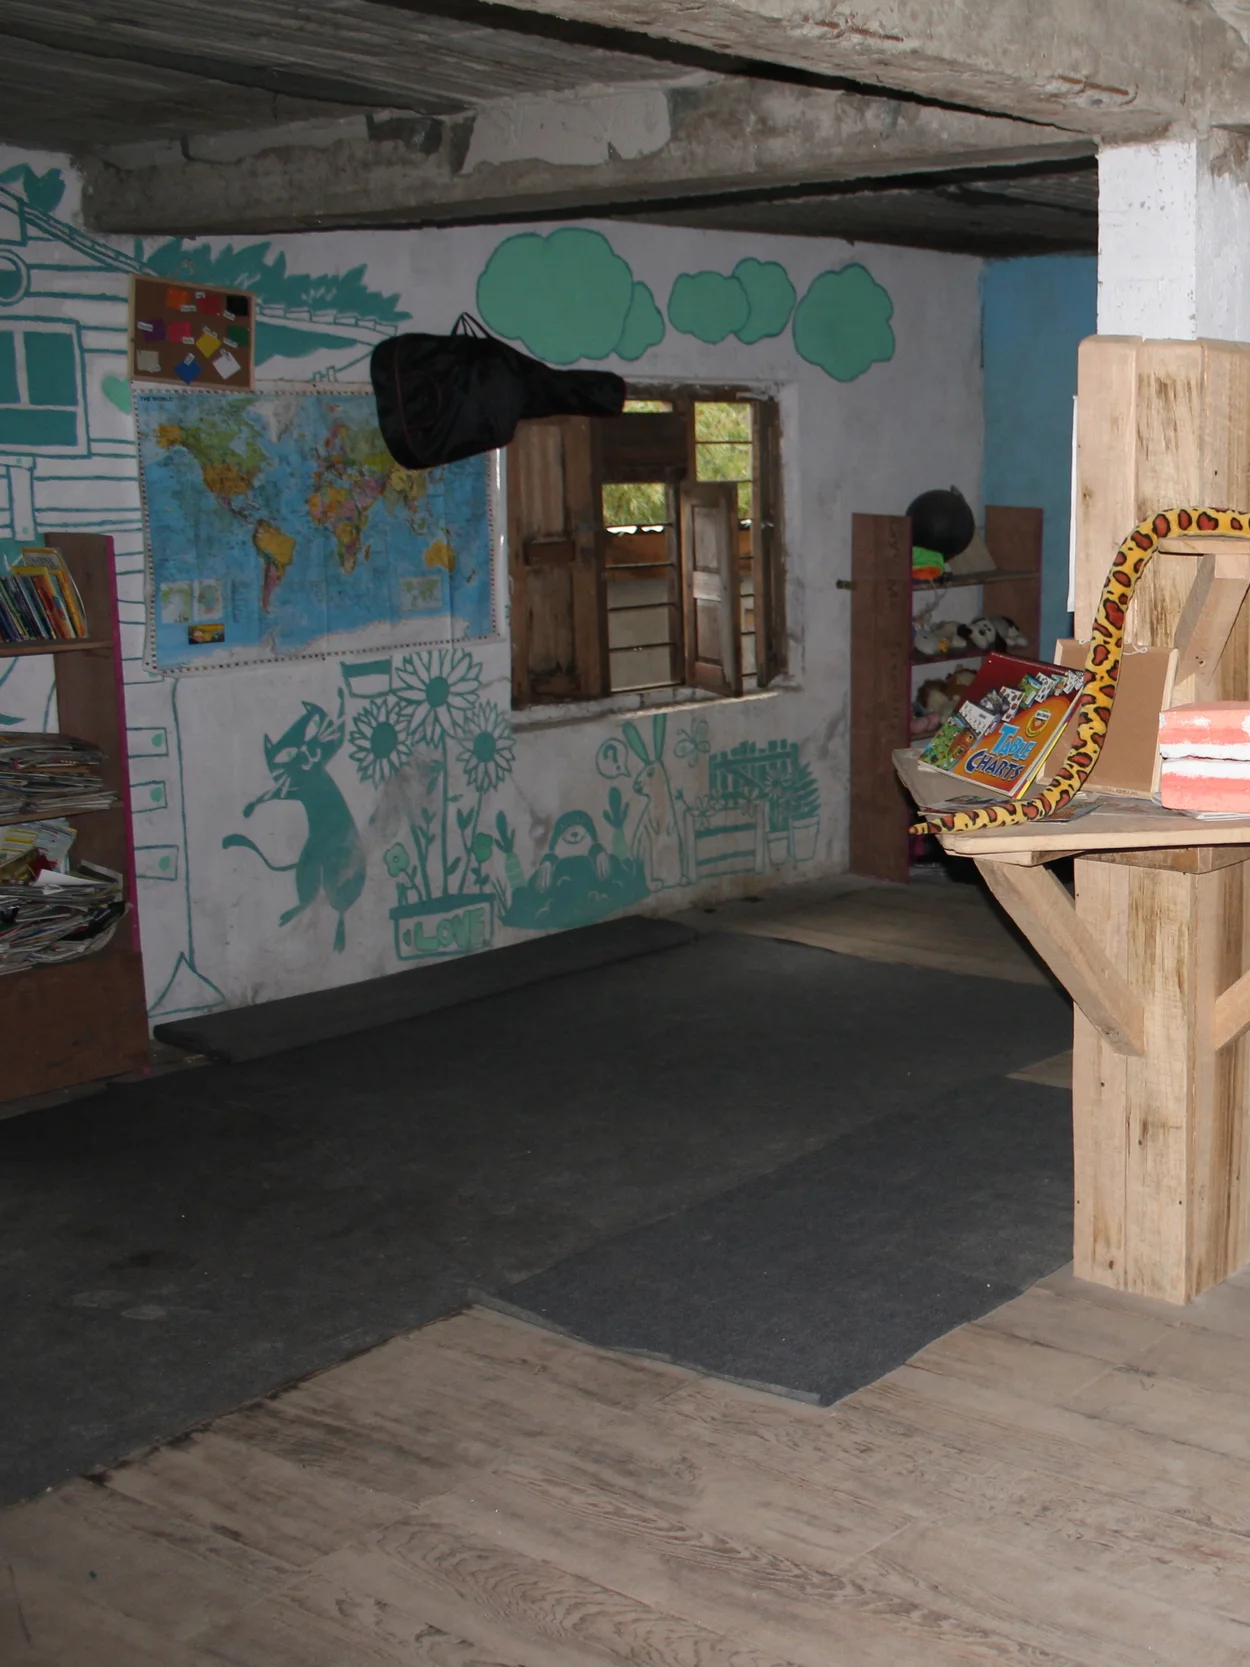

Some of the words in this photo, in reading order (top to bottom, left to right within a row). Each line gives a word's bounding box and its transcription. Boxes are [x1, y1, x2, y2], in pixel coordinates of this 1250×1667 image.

[991, 723, 1037, 760] TABLE
[965, 749, 1025, 781] CHARTS
[413, 907, 485, 953] LOVE
